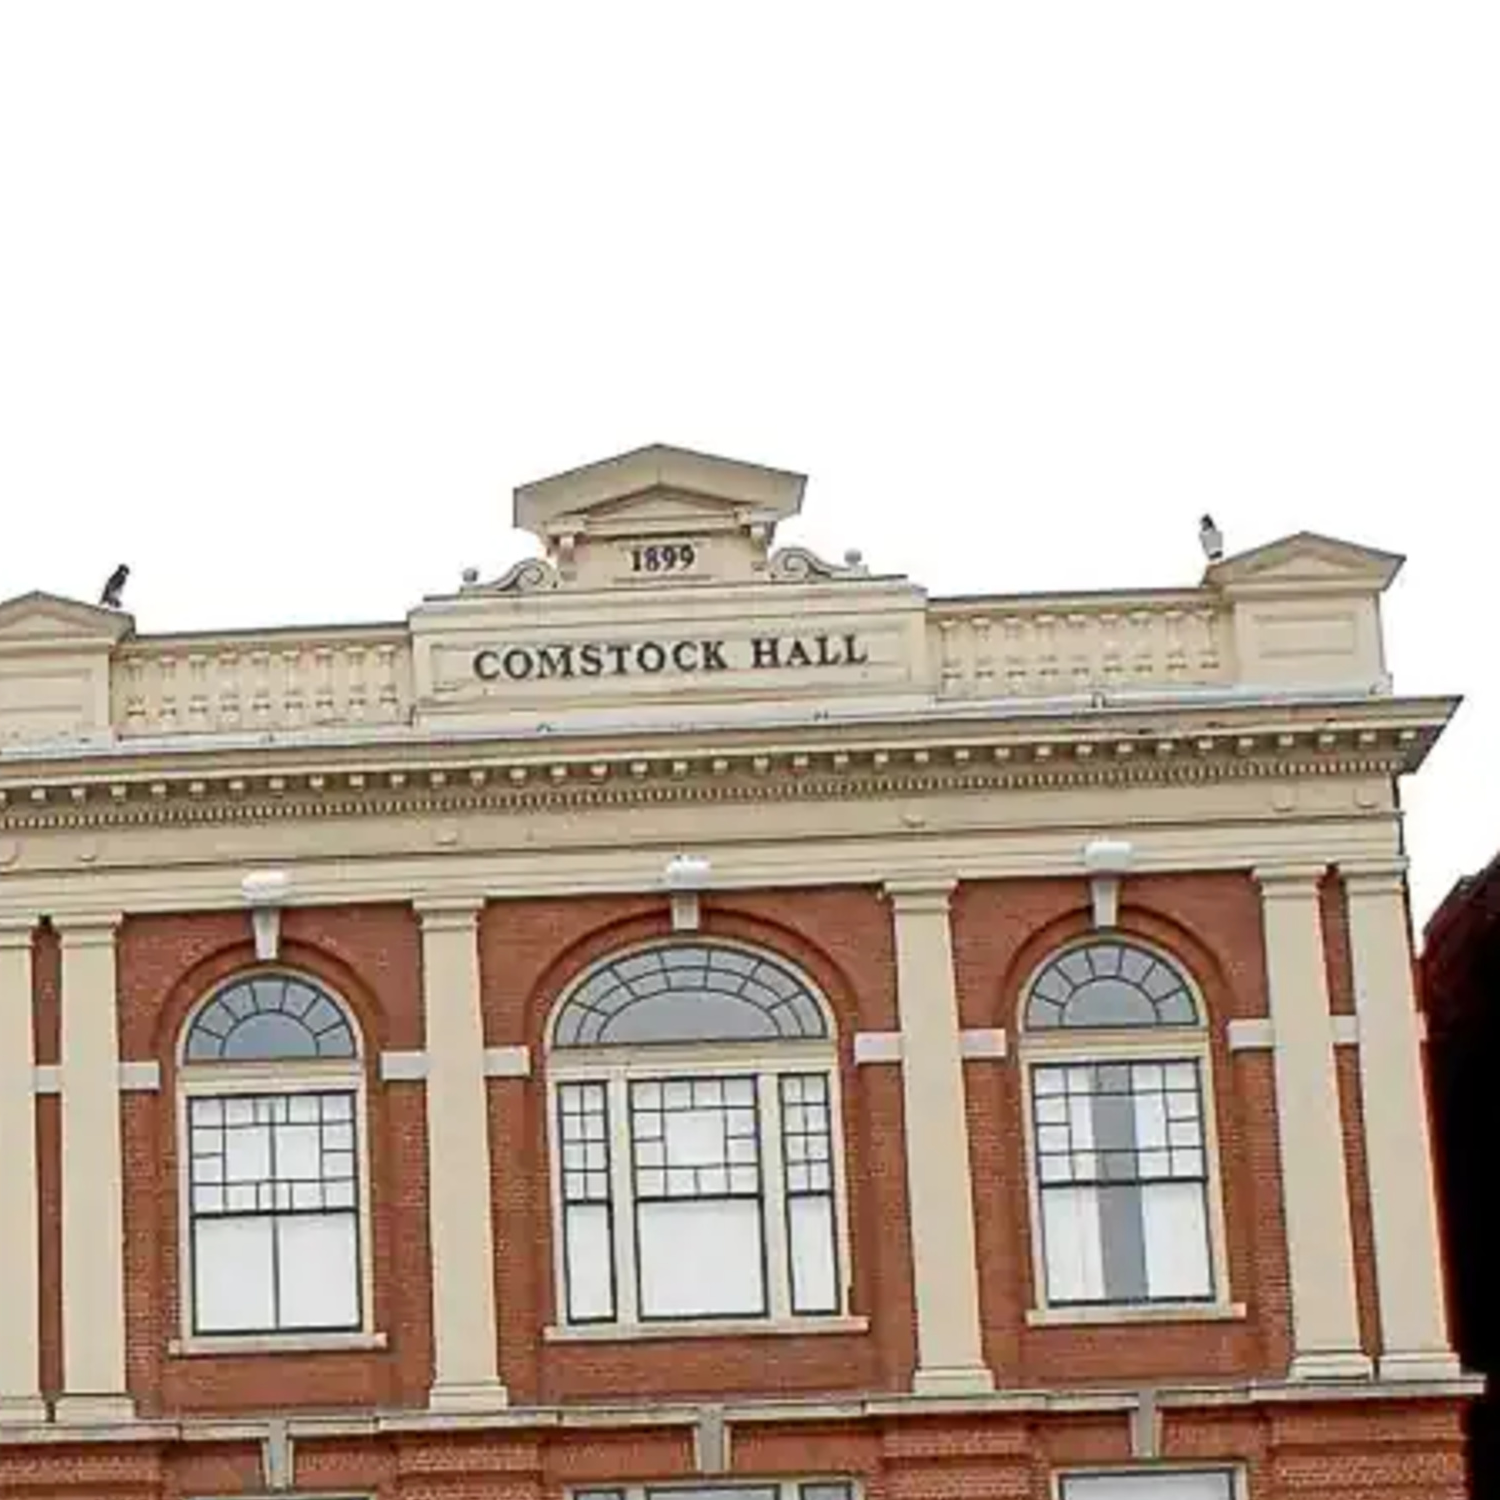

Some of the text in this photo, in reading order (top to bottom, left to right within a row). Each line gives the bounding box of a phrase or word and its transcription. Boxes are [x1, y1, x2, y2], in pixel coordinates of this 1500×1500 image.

[631, 545, 695, 572] 1899
[473, 634, 868, 680] COMSTOCK HALL
